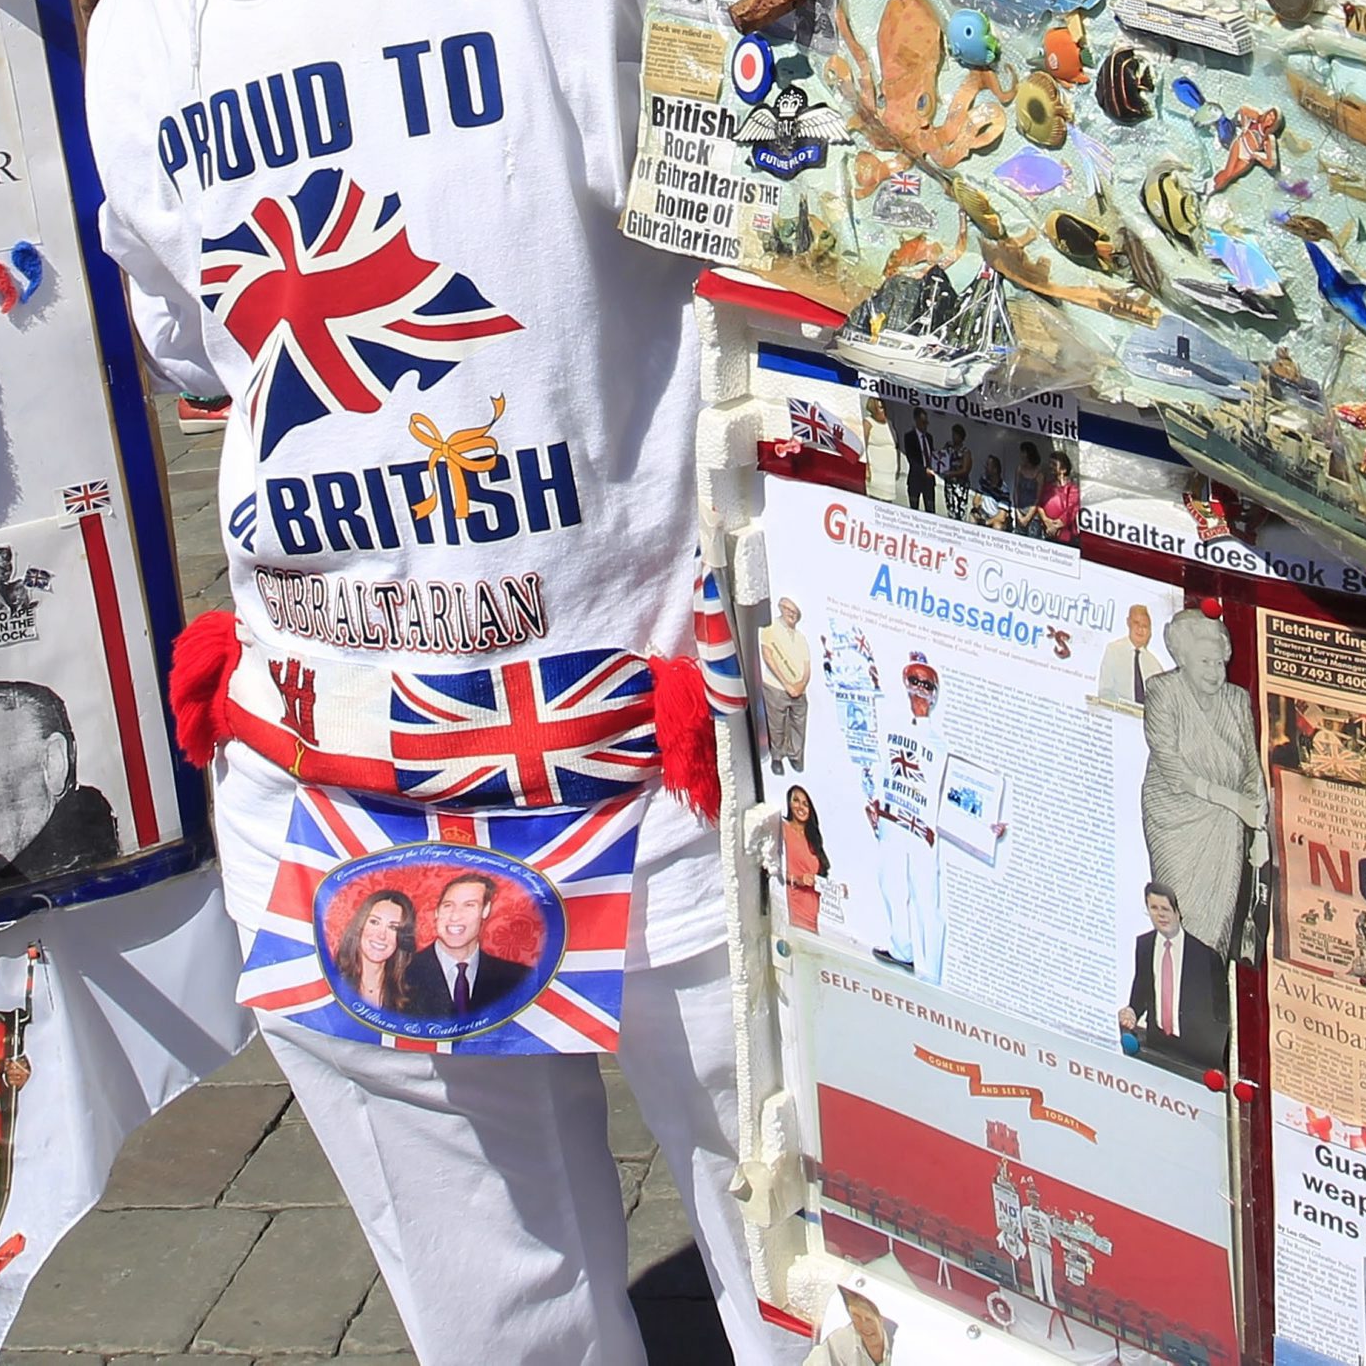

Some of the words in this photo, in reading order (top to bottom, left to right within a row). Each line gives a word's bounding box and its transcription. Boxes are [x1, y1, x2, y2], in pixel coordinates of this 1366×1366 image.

[157, 59, 355, 203] PROUD
[382, 29, 505, 138] TO
[651, 96, 735, 140] British
[664, 131, 712, 167] Rock
[637, 157, 653, 180] of
[759, 183, 779, 206] THE
[655, 189, 709, 225] home
[712, 204, 734, 228] of
[626, 209, 741, 260] Gibraltarians
[1037, 418, 1079, 440] visit
[264, 439, 583, 557] BRITISH
[1077, 506, 1185, 554] Gibraltar
[1193, 540, 1257, 573] does
[1262, 550, 1325, 586] look
[823, 502, 969, 580] Gibraltar's
[976, 558, 1117, 634] Colourful
[10, 617, 36, 630] THE
[253, 565, 546, 655] GIBRALTARIAN
[1272, 618, 1331, 642] Fletcher
[1273, 660, 1297, 673] 020
[1301, 666, 1333, 682] 7493
[887, 733, 918, 752] PROUD
[921, 745, 934, 762] TO
[891, 783, 928, 807] BRITISH
[352, 1001, 398, 1031] William
[428, 1017, 490, 1035] Catherine
[1276, 1002, 1297, 1023] to
[818, 970, 1028, 1059] SELF-DETERMINATION
[1038, 1049, 1059, 1070] IS
[1068, 1059, 1201, 1122] DEMOCRACY
[1293, 1199, 1359, 1239] rams
